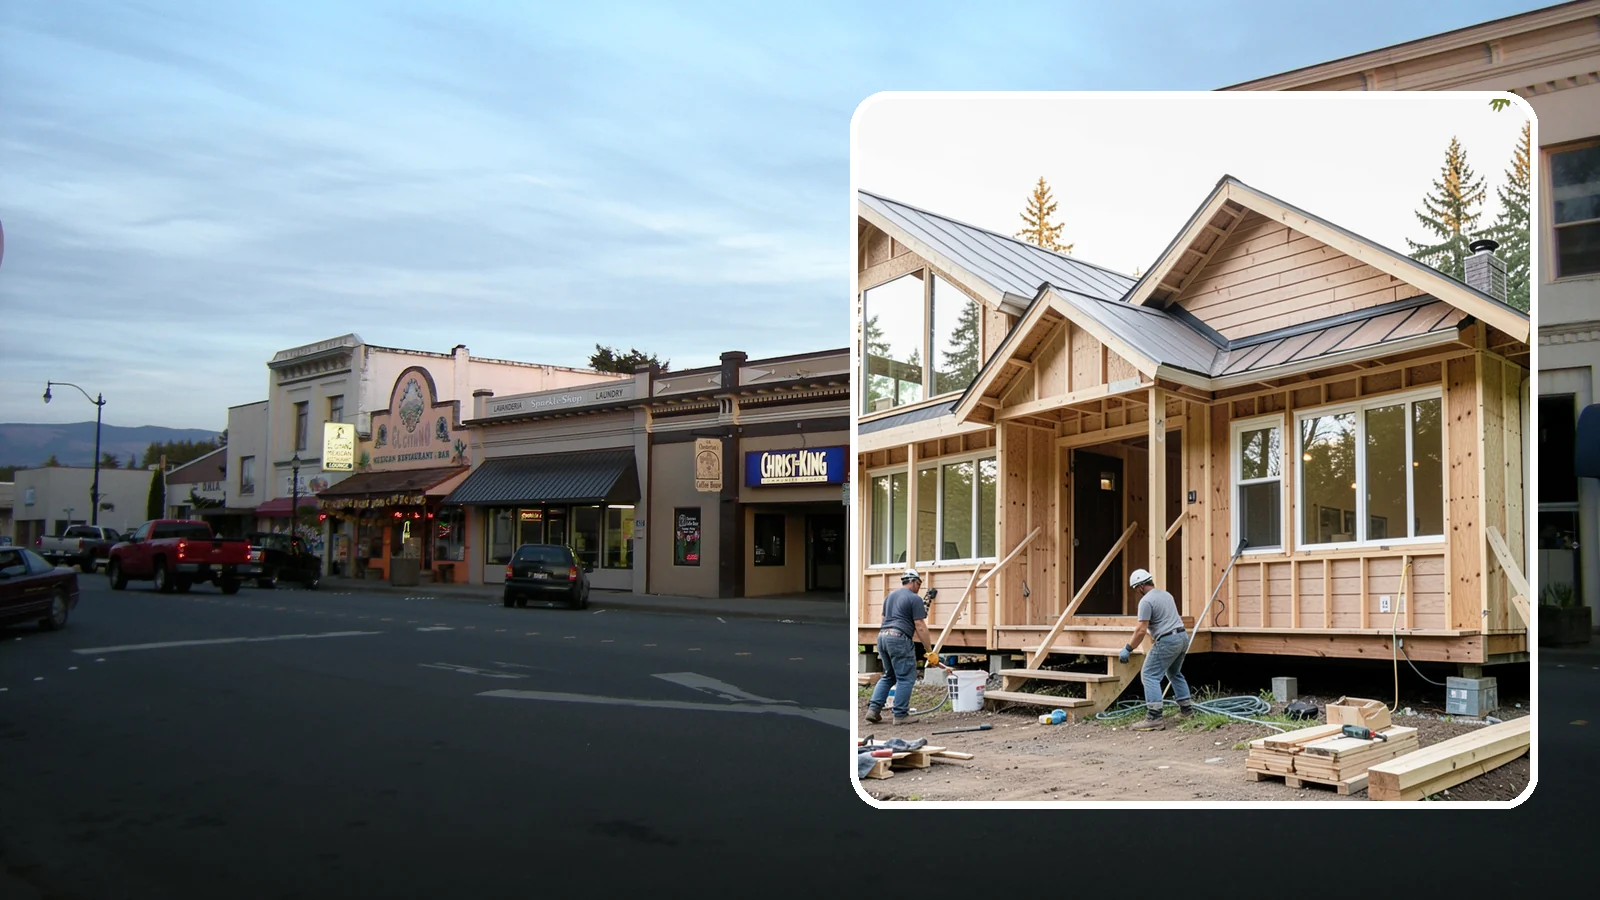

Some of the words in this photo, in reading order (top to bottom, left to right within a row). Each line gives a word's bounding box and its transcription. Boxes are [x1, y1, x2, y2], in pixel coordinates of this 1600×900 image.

[493, 402, 523, 412] LAVANDERIA
[530, 397, 561, 409] Sparkle
[562, 394, 583, 405] Shop
[595, 388, 624, 400] LAUNDRY
[373, 454, 396, 464] MEXICAN
[397, 451, 433, 462] RESTAURANT
[438, 450, 450, 459] BAR
[761, 452, 796, 477] CHRIST
[799, 450, 827, 476] KING
[696, 481, 709, 489] Coffee
